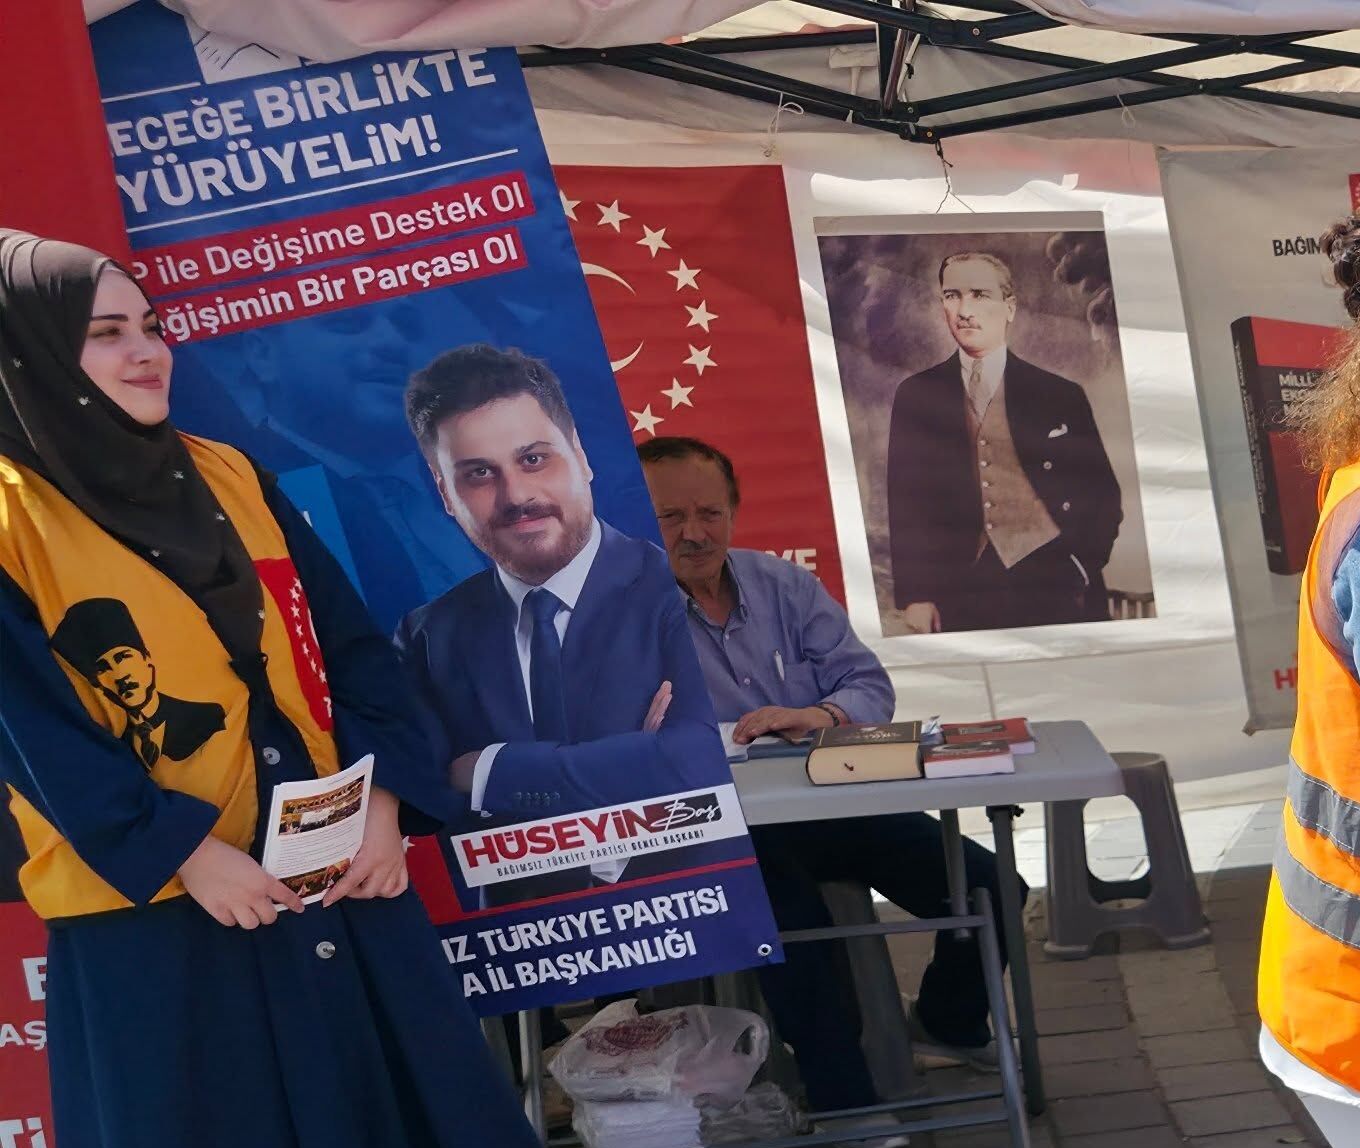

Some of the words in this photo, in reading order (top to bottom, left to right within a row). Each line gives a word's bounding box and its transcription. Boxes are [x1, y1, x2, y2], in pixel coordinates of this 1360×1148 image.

[108, 96, 253, 157] ECEĞE
[116, 113, 443, 214] YÜRÜYELİM!
[155, 256, 200, 286] ile
[204, 222, 367, 276] Değişime
[371, 197, 484, 239] Destek
[492, 181, 525, 216] Ol
[299, 277, 346, 308] Bir
[356, 248, 481, 303] Parçası
[484, 234, 519, 267] Ol
[461, 804, 652, 869] HÜSEYİN
[497, 859, 543, 877] BAĞIMSIZ
[547, 851, 587, 868] TÜRKİYE
[590, 844, 628, 859] PARTİSİ
[631, 838, 659, 852] GENEL
[663, 830, 705, 845] BAŞKANI
[477, 909, 612, 953] TÜRKİYE
[614, 885, 729, 931] PARTİSİ
[489, 962, 515, 993] İL
[516, 927, 697, 988] BAŞKANLIĞI
